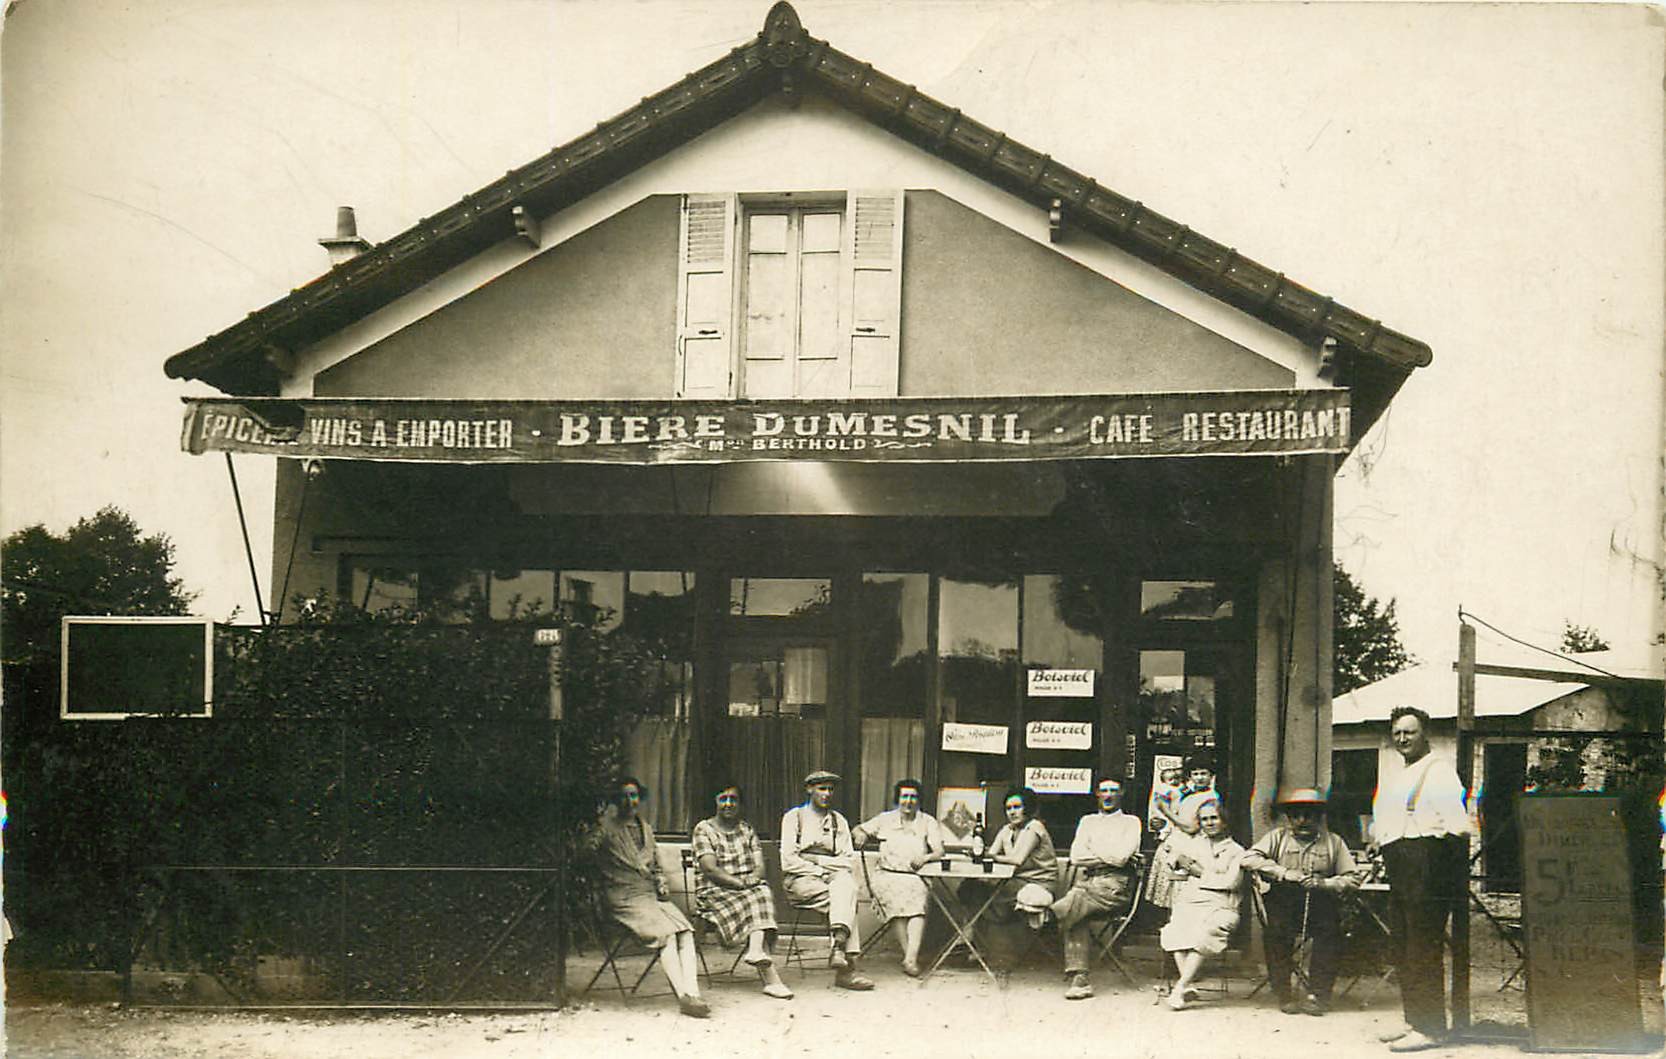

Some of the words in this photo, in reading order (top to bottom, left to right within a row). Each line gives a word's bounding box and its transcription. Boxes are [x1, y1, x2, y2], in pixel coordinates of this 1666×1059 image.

[310, 418, 362, 446] VINS
[370, 420, 387, 447] A
[395, 419, 513, 448] EMPORTER
[557, 413, 726, 447] BIERE
[751, 411, 1032, 445] DUMESNIL
[1182, 406, 1350, 442] RESTAURANT
[751, 437, 867, 451] BERTHOLD
